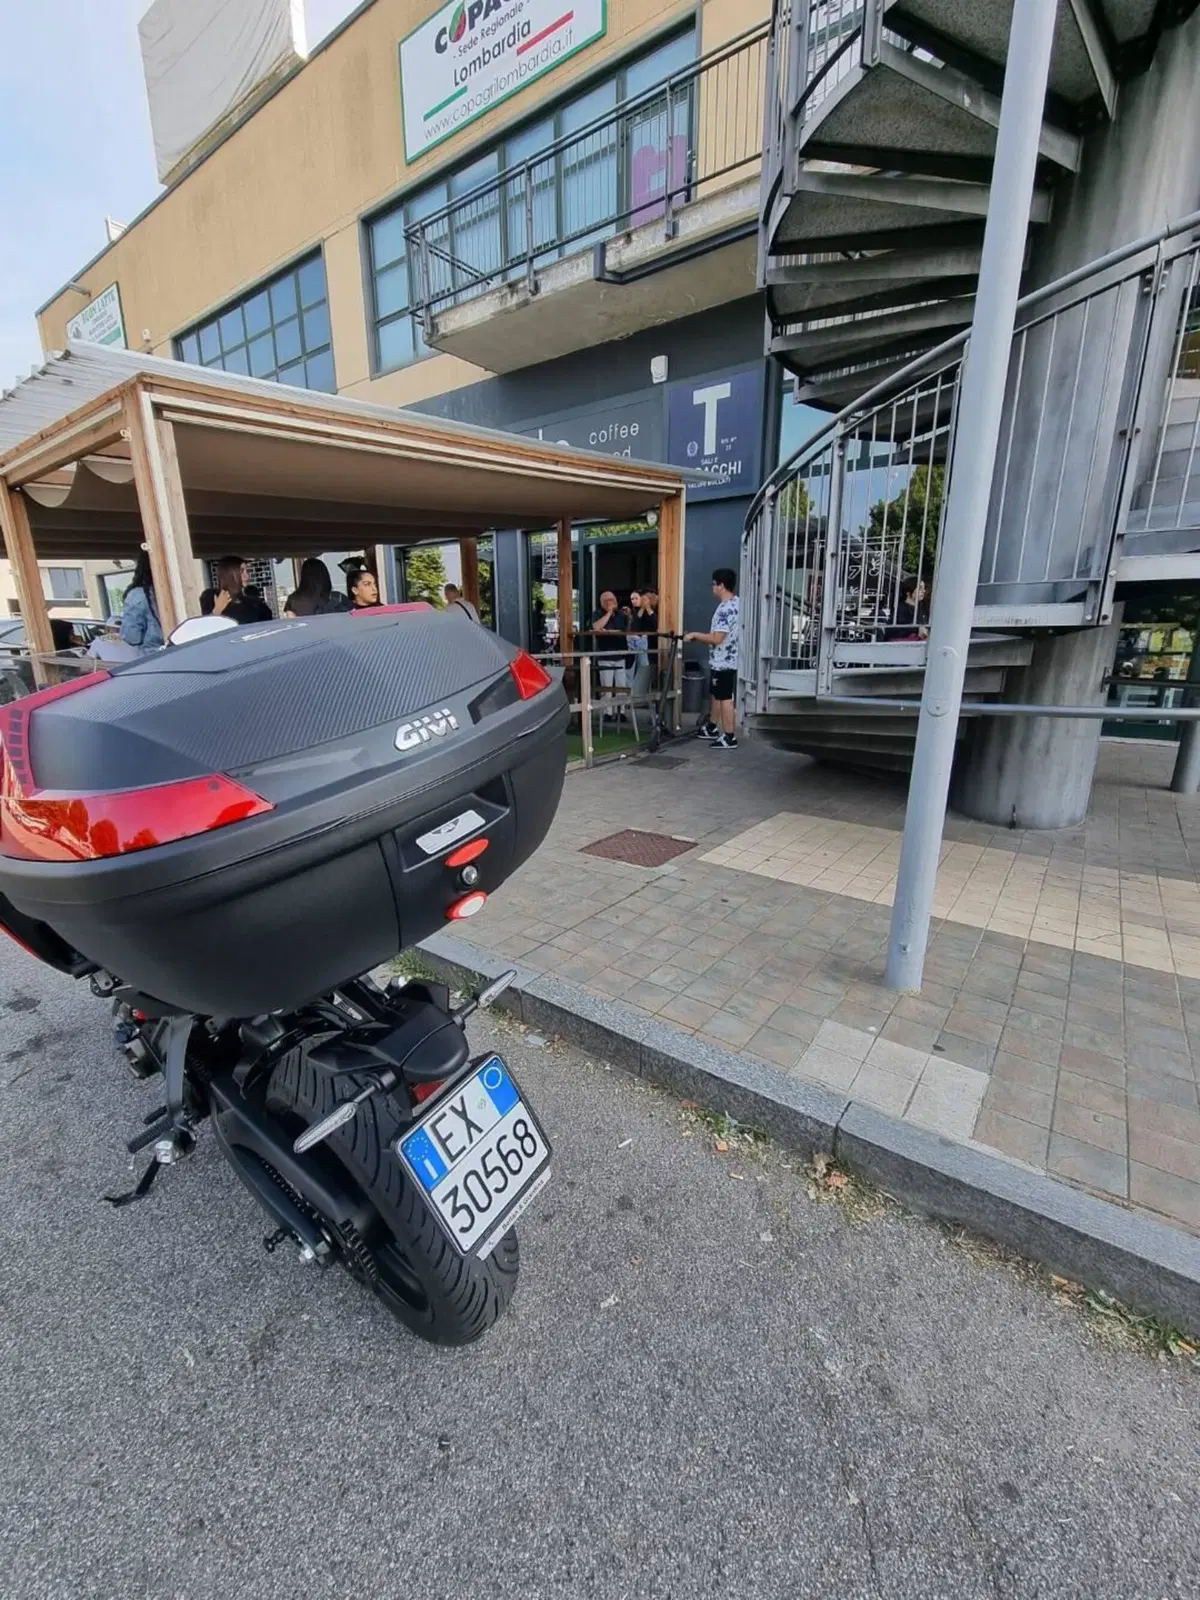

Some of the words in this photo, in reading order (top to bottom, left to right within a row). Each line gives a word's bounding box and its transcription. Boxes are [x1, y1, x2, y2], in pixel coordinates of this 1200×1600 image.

[453, 19, 531, 87] Lombardia
[458, 35, 479, 57] Sede
[480, 2, 524, 40] Regionale
[424, 29, 574, 140] www.copagrilombardia.it
[589, 423, 639, 444] coffee
[692, 382, 731, 455] T
[428, 1095, 484, 1164] EX
[441, 1118, 537, 1234] 30568
